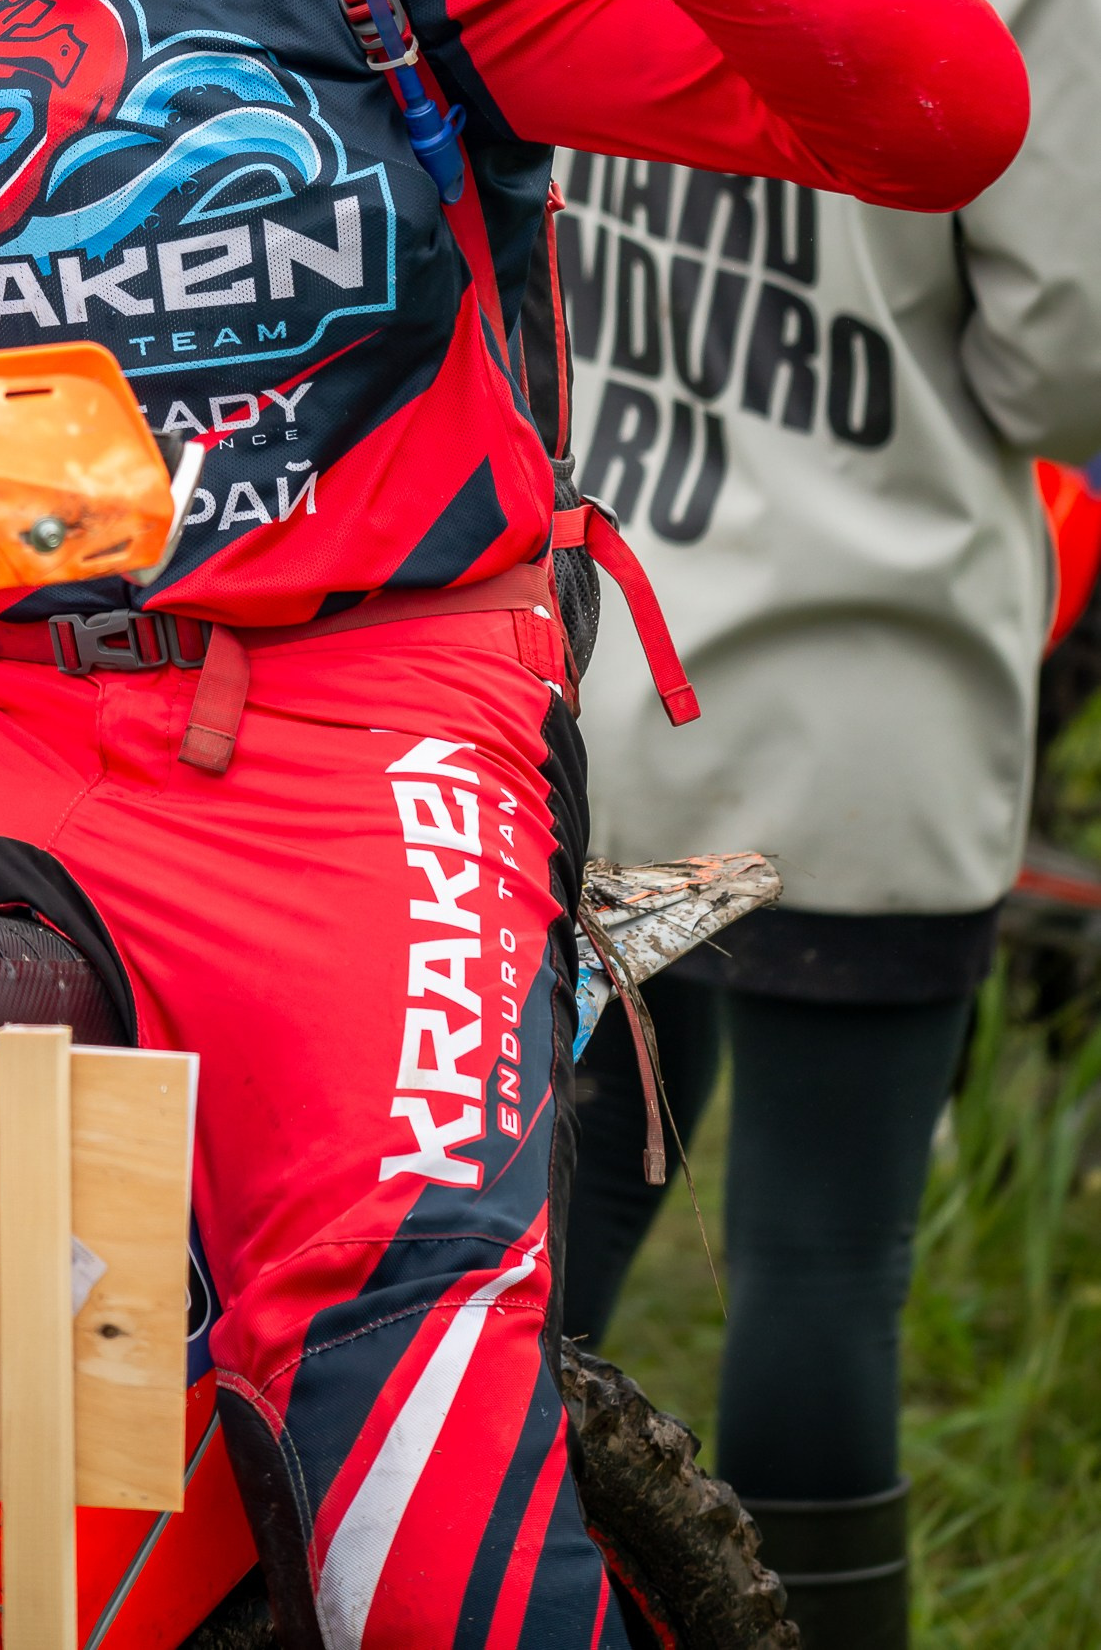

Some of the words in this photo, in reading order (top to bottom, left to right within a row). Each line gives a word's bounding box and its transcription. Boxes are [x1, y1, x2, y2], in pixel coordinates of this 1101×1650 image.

[129, 321, 289, 356] TEAM
[554, 213, 897, 453] NDURO
[497, 788, 520, 900] TEAM
[497, 926, 522, 1138] ENDURO
